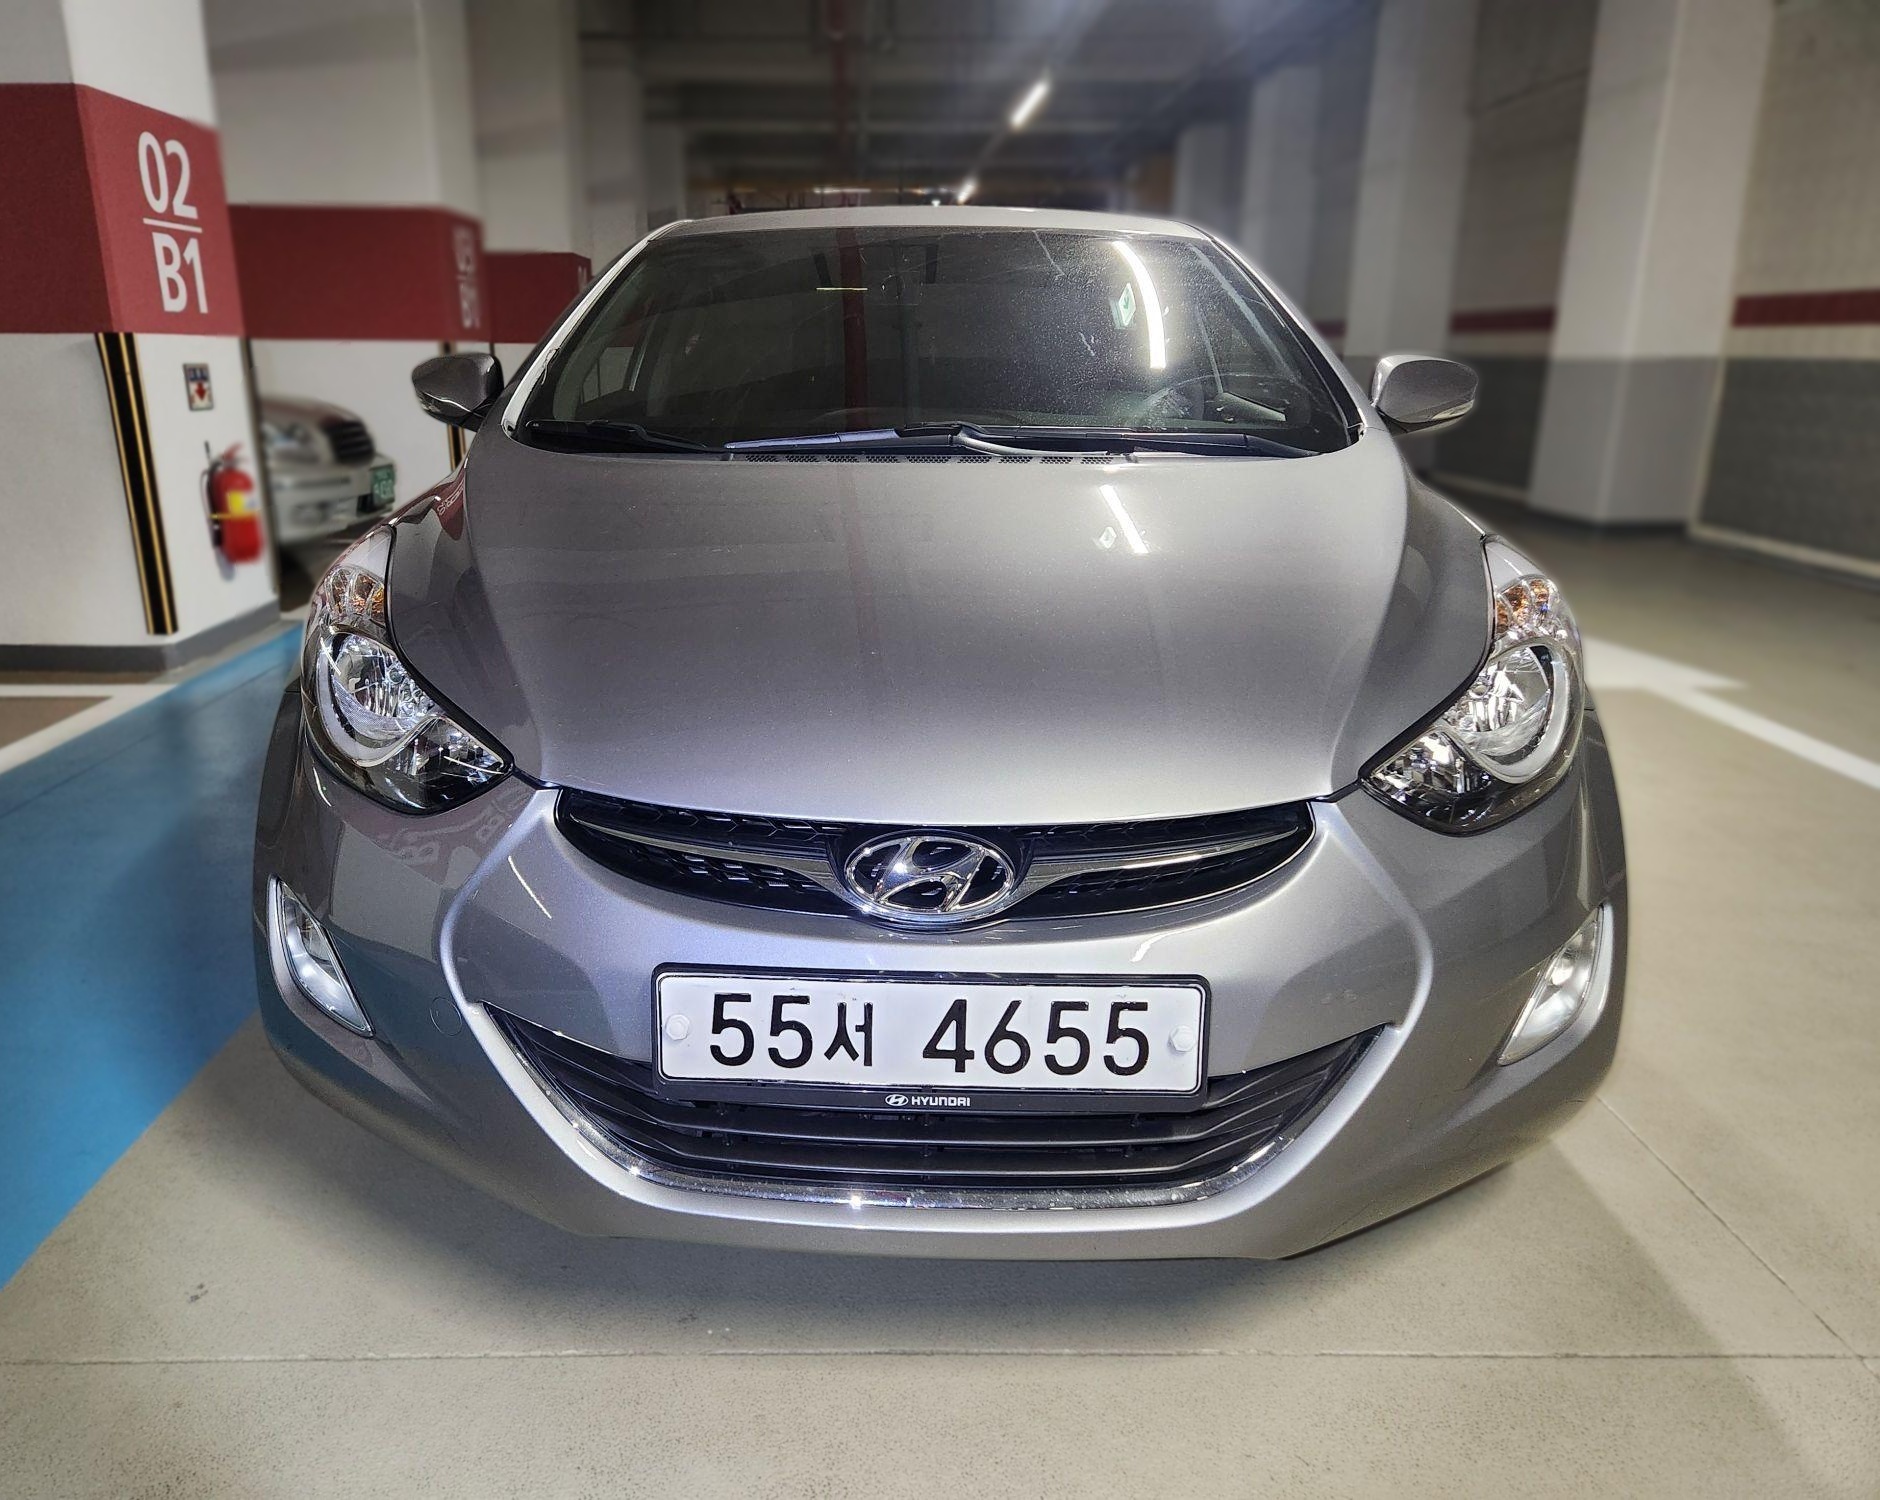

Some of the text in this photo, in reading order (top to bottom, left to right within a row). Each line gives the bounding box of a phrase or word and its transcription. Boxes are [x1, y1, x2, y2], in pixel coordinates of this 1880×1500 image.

[138, 131, 198, 219] 02
[152, 231, 208, 314] B1
[710, 992, 1149, 1076] 55서 4655
[911, 1096, 971, 1107] HYUNDAI
